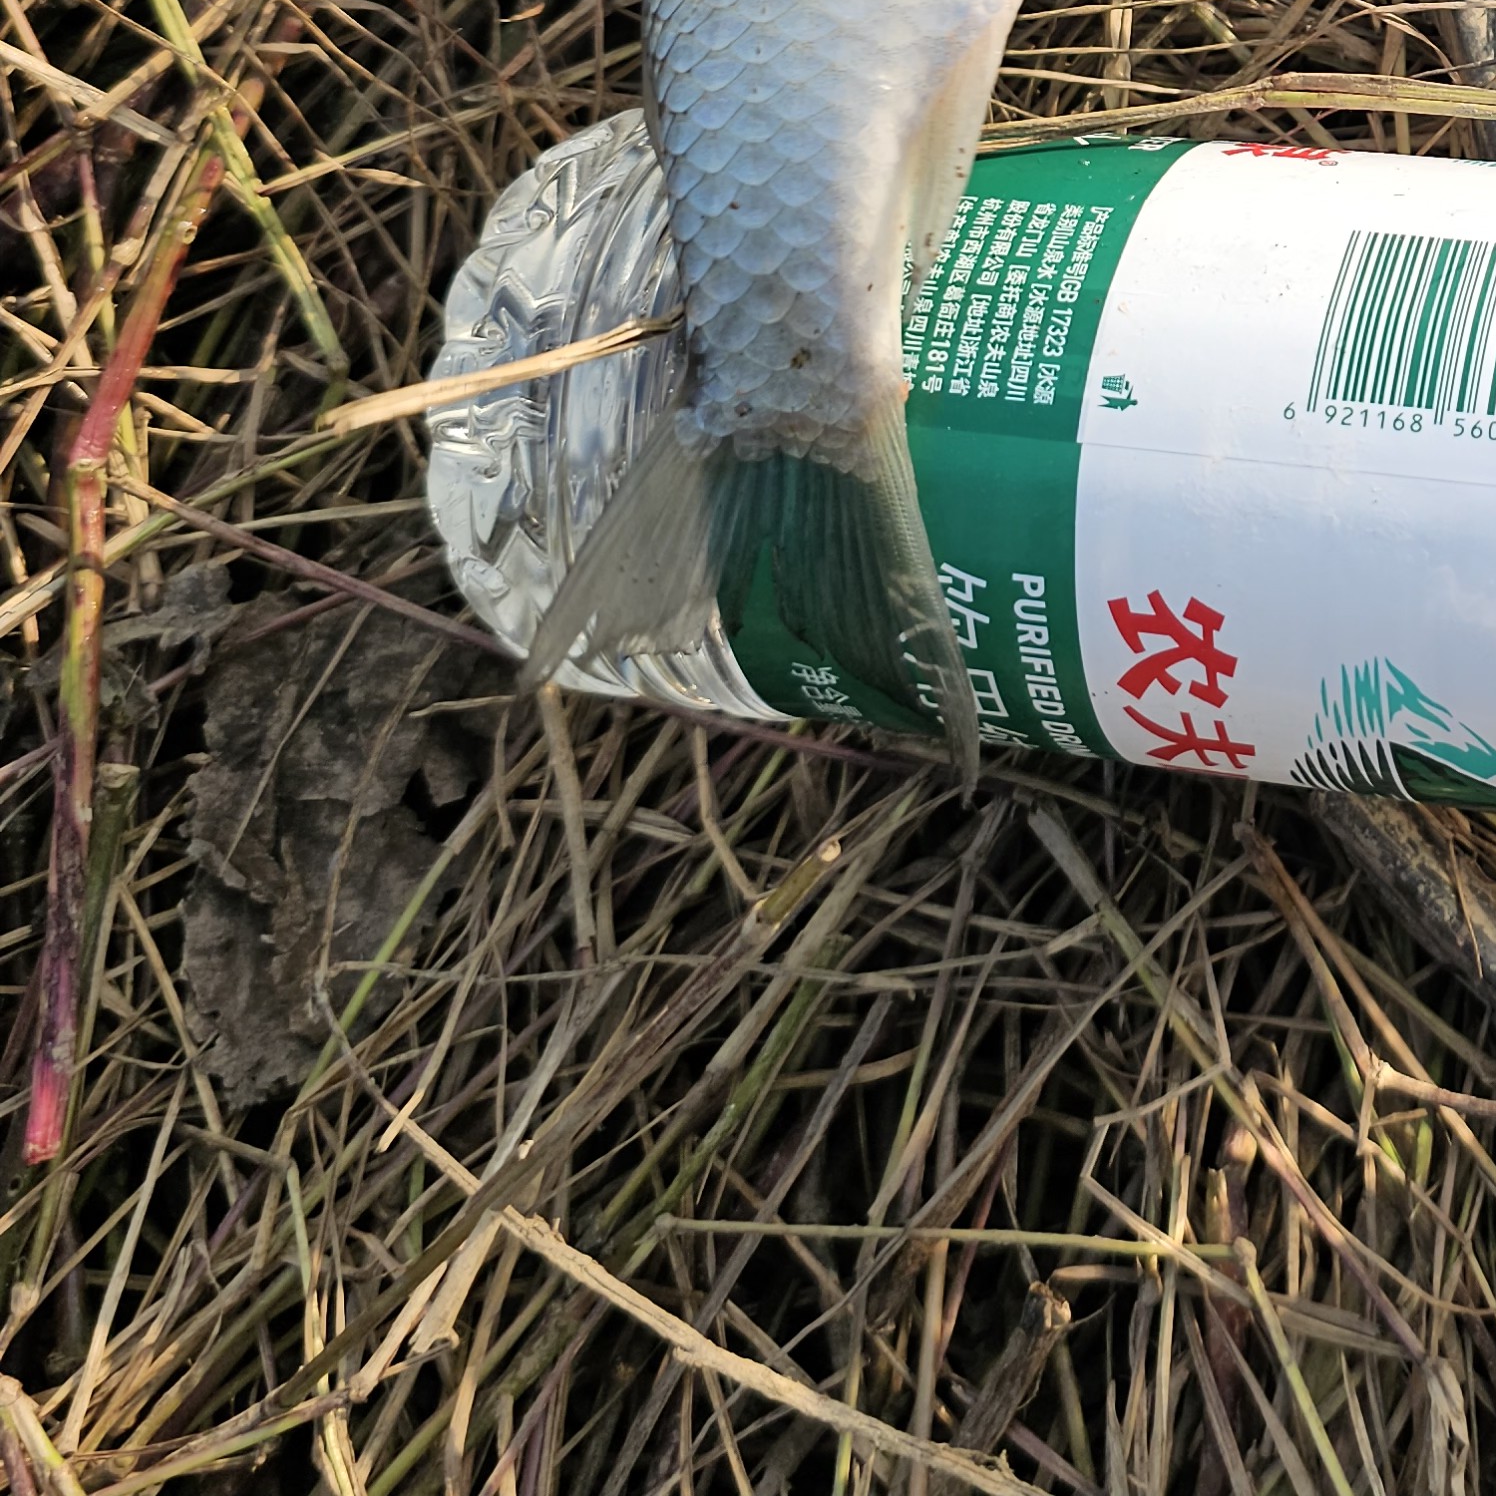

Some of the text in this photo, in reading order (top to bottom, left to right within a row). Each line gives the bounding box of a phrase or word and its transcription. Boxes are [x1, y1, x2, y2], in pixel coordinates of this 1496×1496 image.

[976, 199, 1021, 286] 股份有限公司
[1015, 202, 1057, 258] 省龙门山
[1042, 307, 1074, 358] 17323
[1283, 401, 1296, 420] 6
[1324, 404, 1424, 433] 921168
[1011, 572, 1067, 716] PURIFIED
